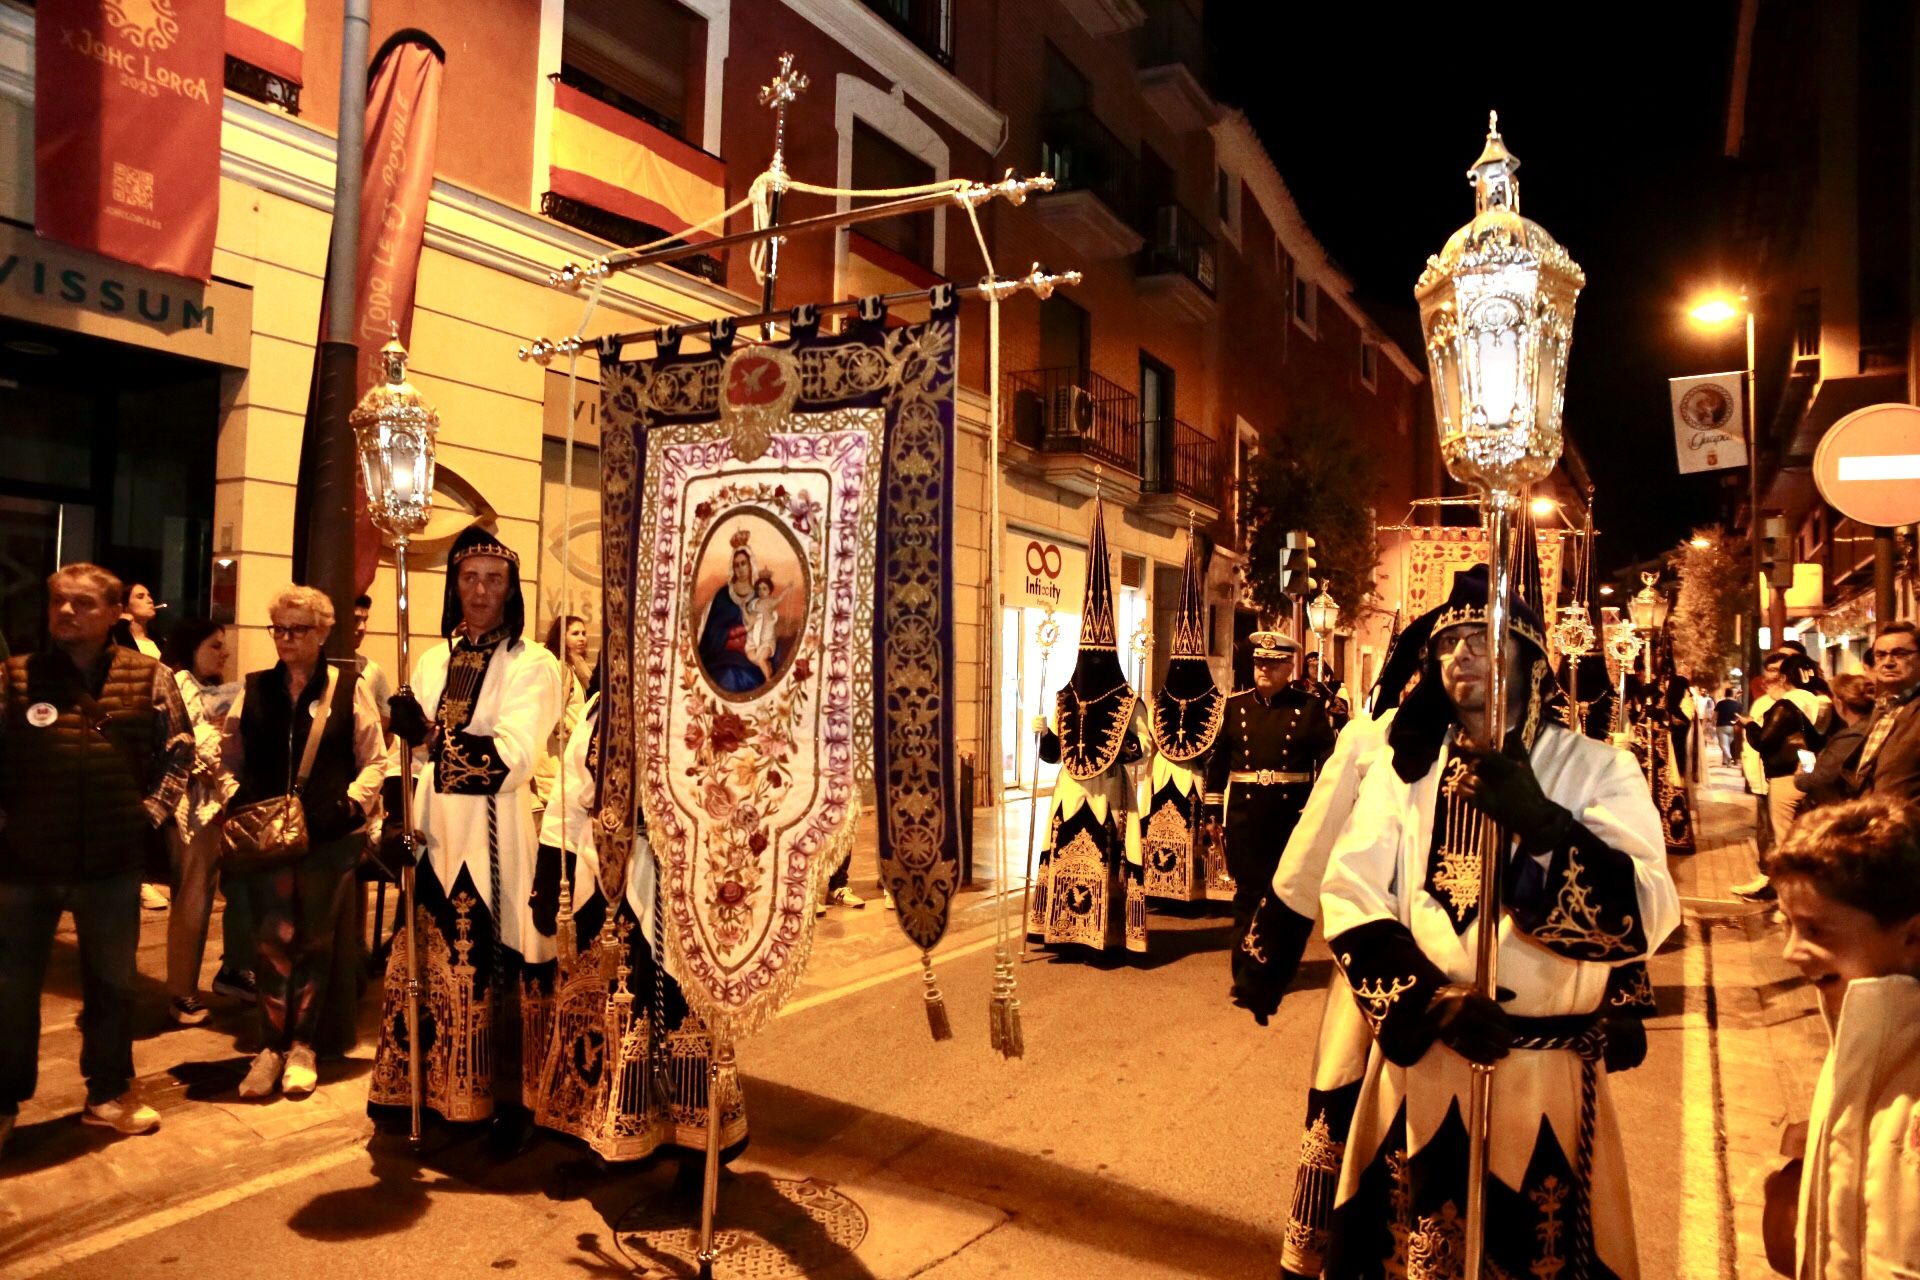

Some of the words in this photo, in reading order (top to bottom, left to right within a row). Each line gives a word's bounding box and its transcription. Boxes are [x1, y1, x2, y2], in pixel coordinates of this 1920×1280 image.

[79, 28, 136, 75] JOHC
[382, 89, 410, 187] POSIBLE
[371, 238, 395, 268] LE
[359, 277, 393, 341] TODO
